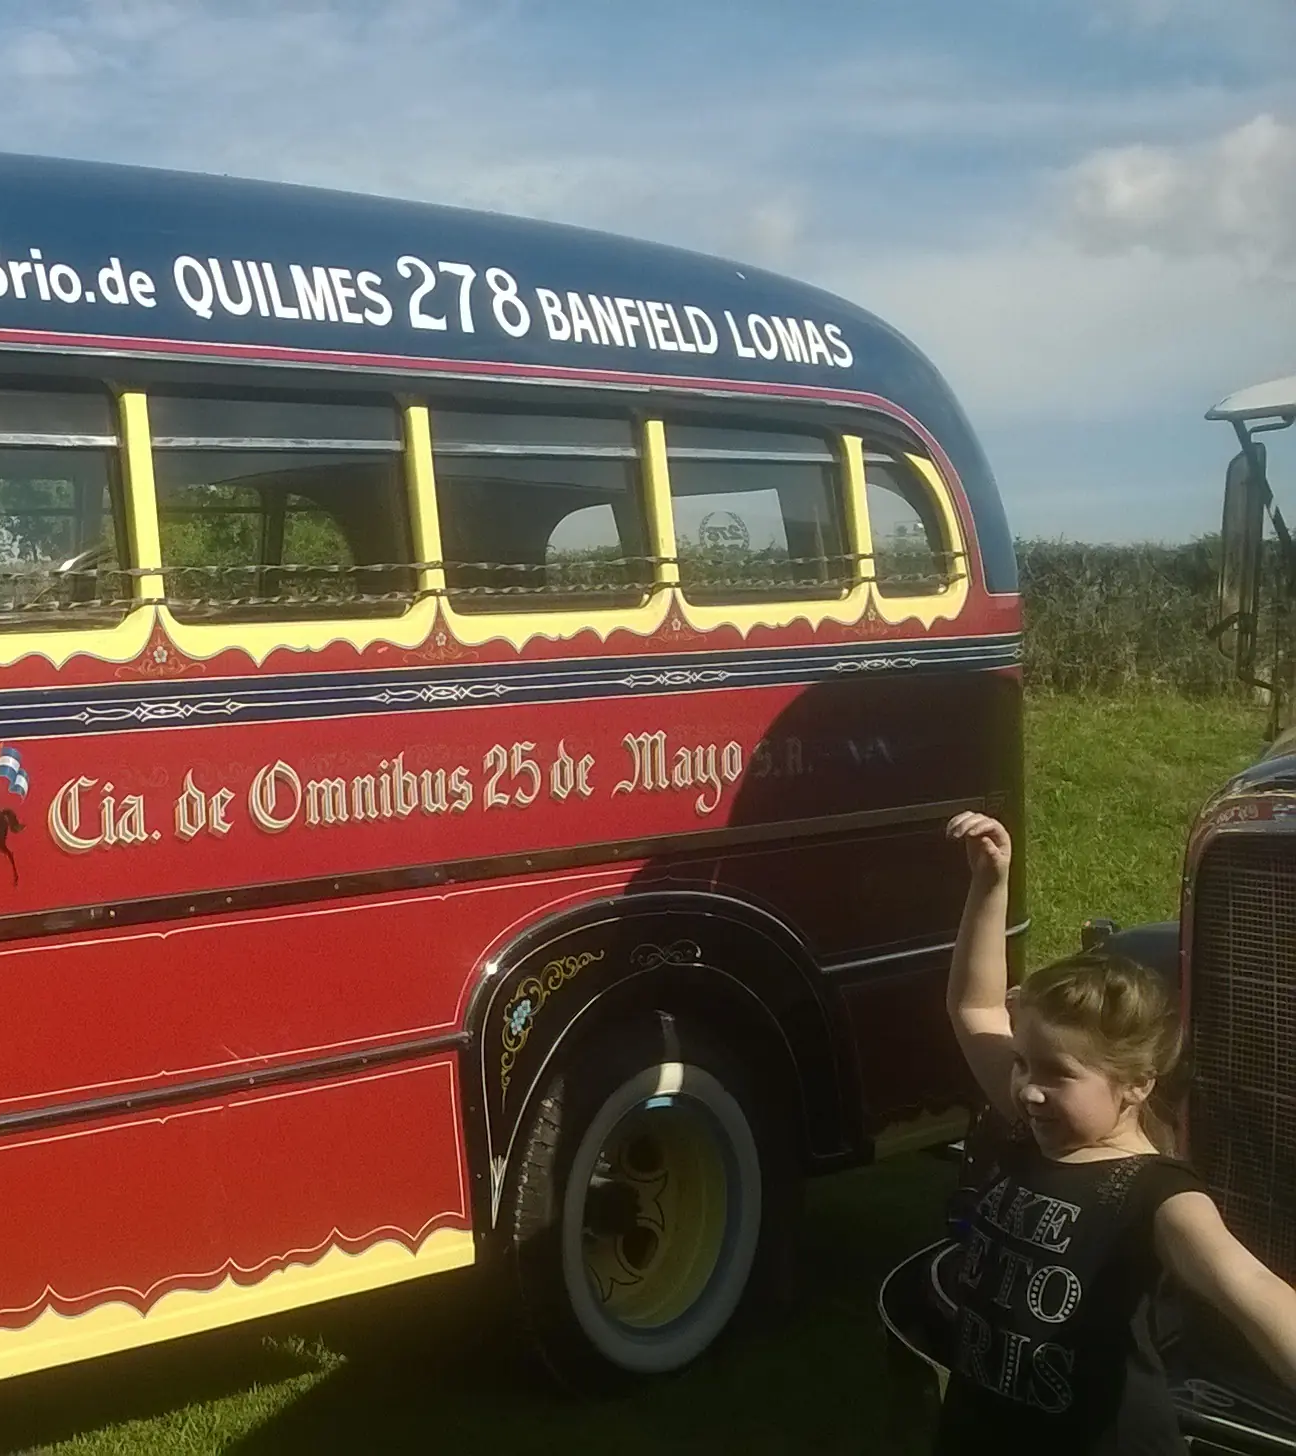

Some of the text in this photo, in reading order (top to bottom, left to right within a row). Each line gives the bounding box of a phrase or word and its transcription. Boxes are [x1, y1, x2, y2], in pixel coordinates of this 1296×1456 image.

[171, 254, 394, 328] QUILMES
[395, 254, 532, 339] 278
[535, 286, 720, 356] BANFIELD
[725, 310, 855, 370] LOMAS
[46, 773, 164, 855] Cia.
[173, 766, 237, 843] de
[247, 749, 474, 834] Omnibus
[481, 738, 542, 813] 25
[548, 737, 596, 801] de
[610, 728, 744, 818] Mayo
